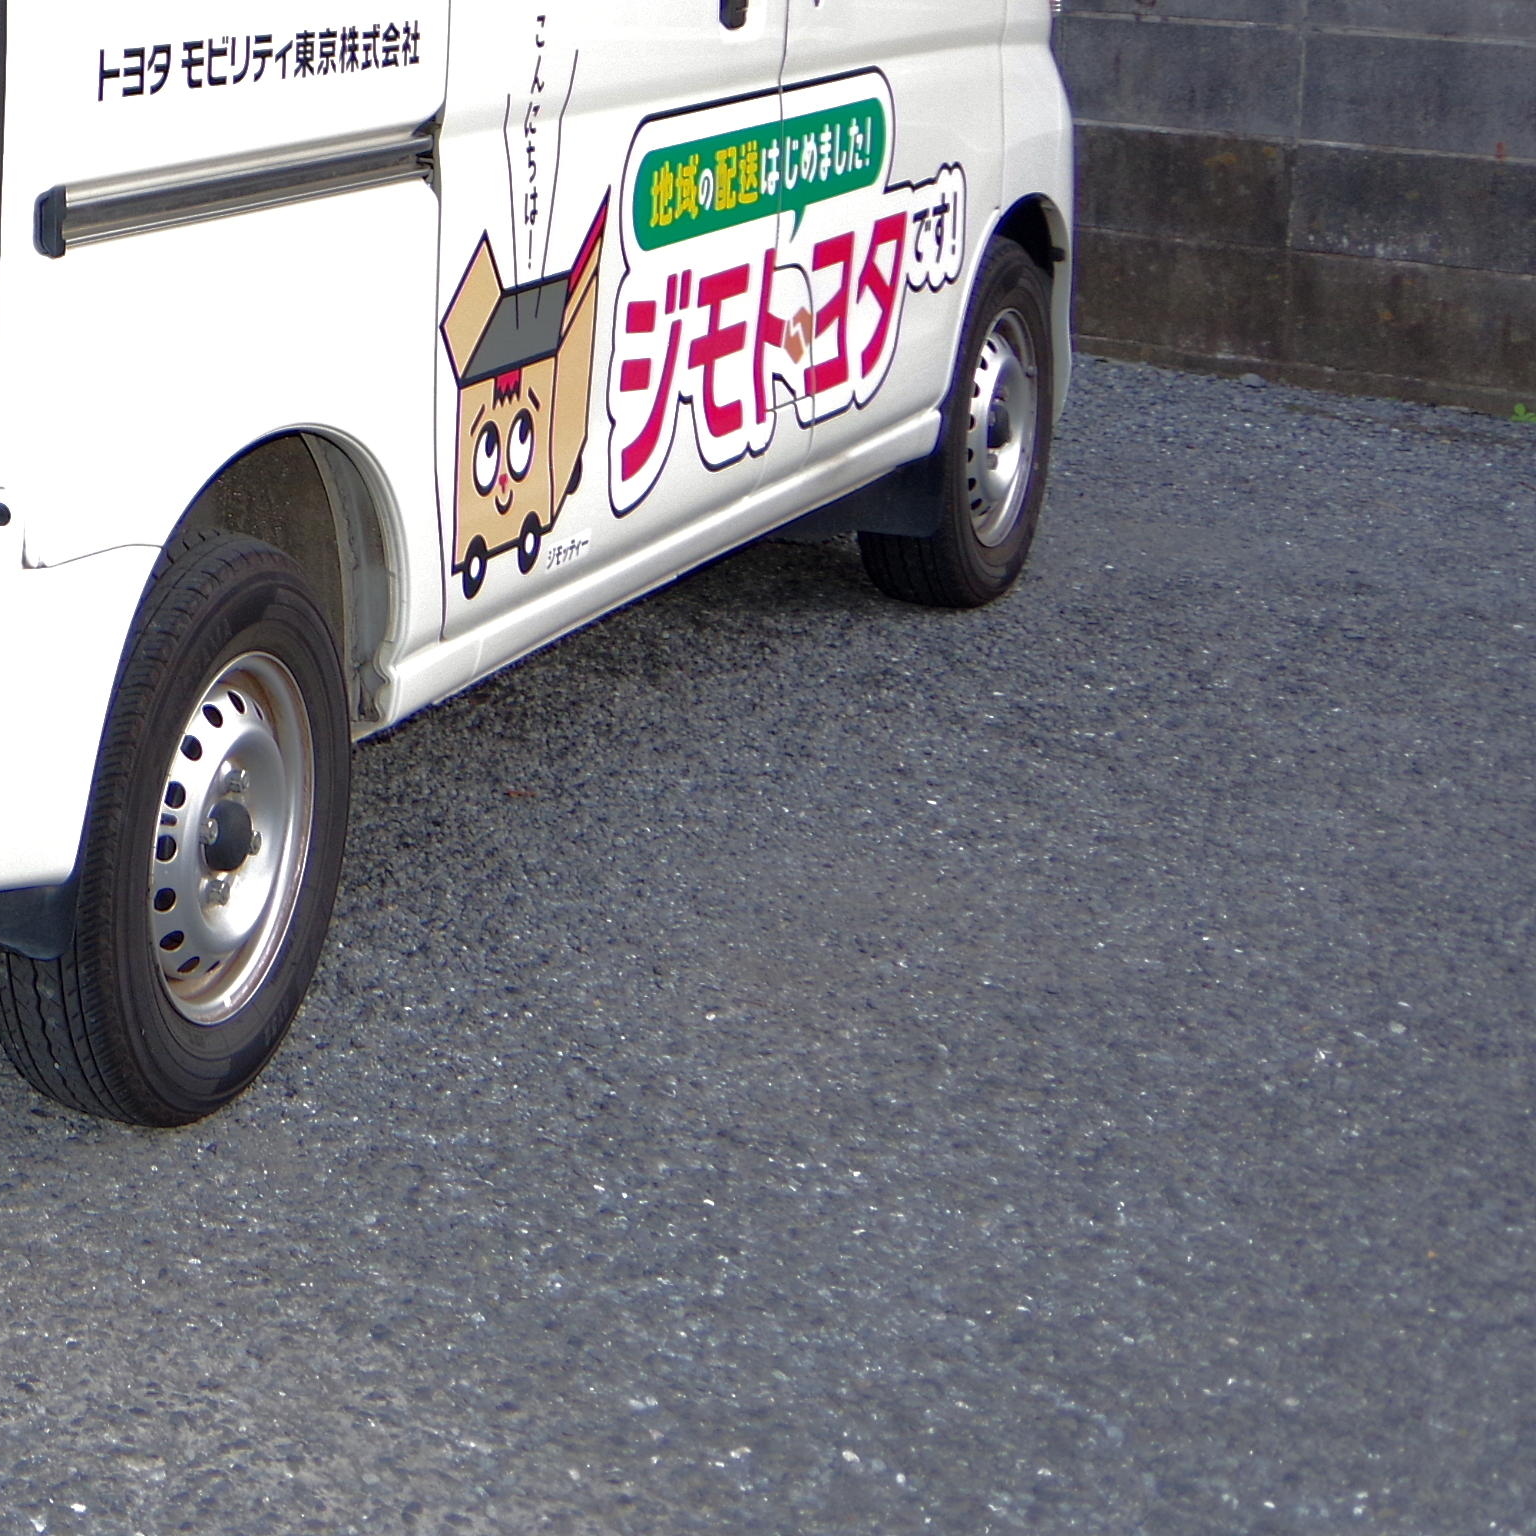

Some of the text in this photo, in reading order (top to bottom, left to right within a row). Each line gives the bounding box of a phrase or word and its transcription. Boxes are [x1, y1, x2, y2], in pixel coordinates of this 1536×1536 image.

[98, 20, 421, 102] トヨタ モビリティ東京株式会社
[649, 116, 873, 228] 地域の配送はじめました!
